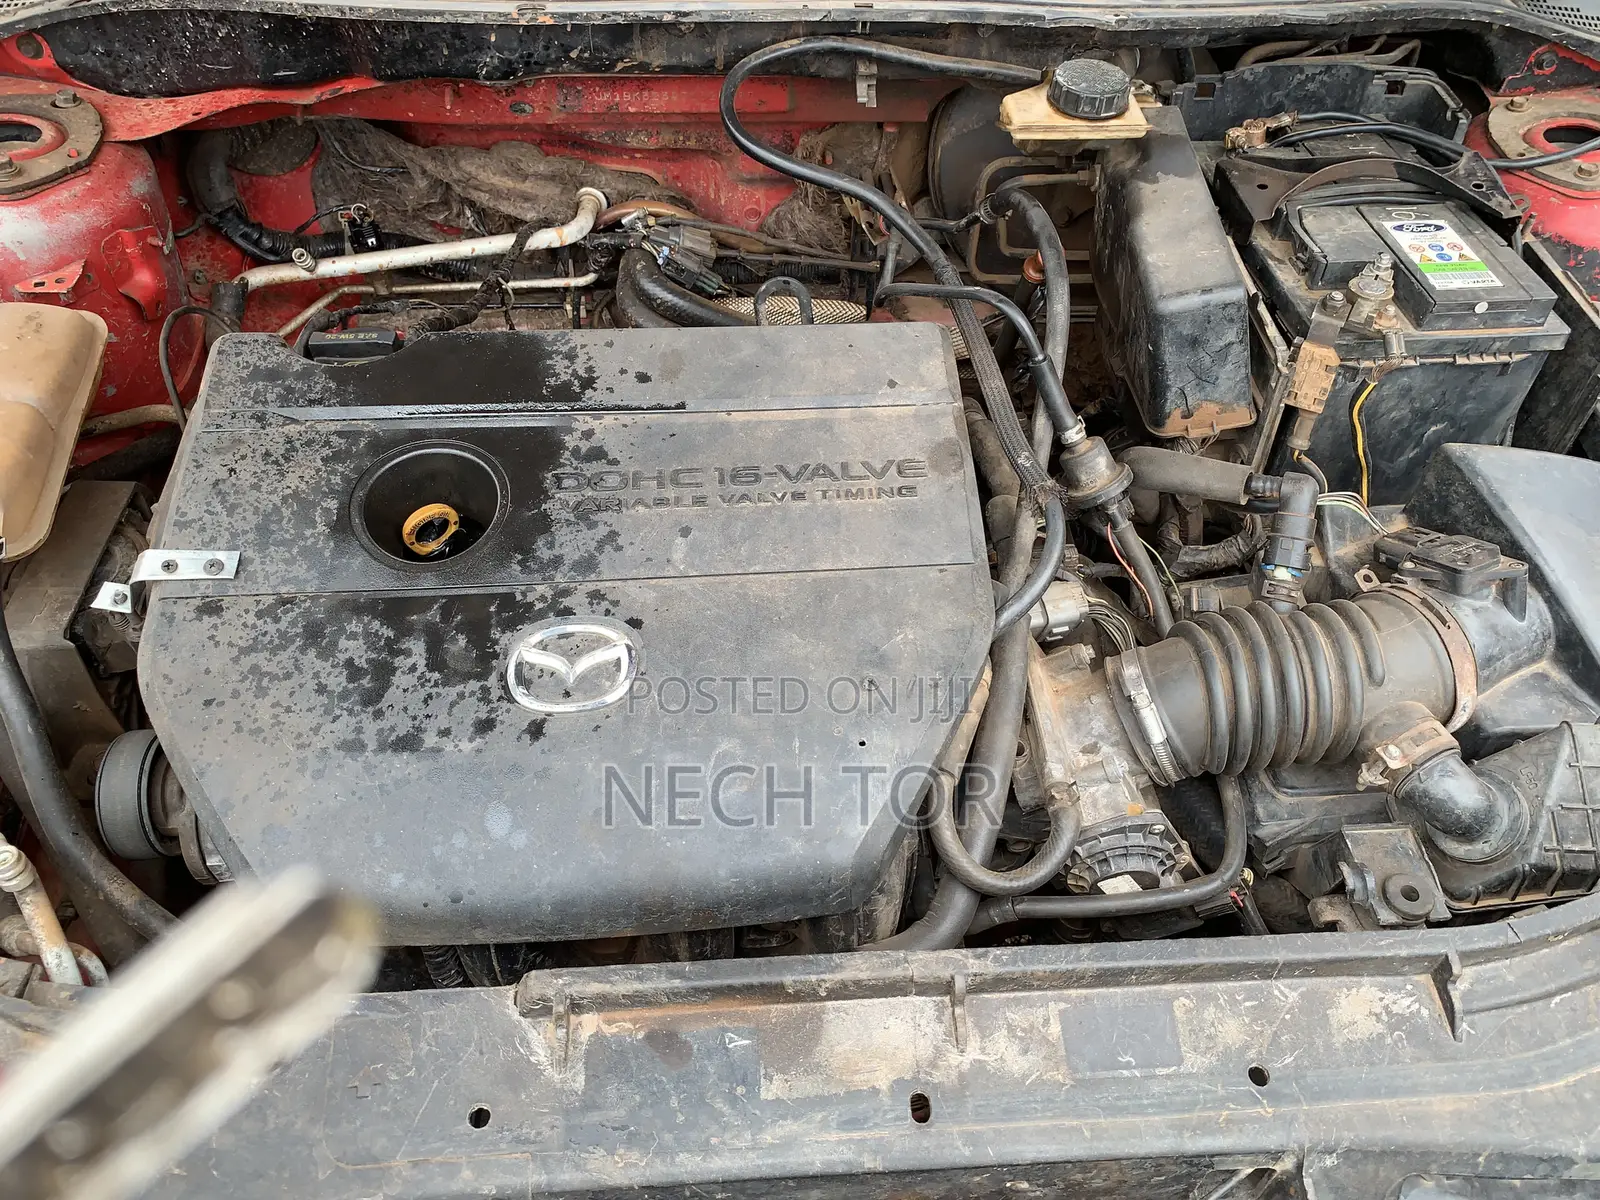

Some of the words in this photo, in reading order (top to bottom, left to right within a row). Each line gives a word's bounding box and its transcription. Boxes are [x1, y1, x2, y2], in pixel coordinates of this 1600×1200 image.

[551, 467, 703, 493] DOHC
[714, 458, 929, 487] 16-VALVE
[559, 494, 709, 513] VARIABLE
[718, 490, 808, 506] VALVE
[816, 485, 918, 501] TIMING
